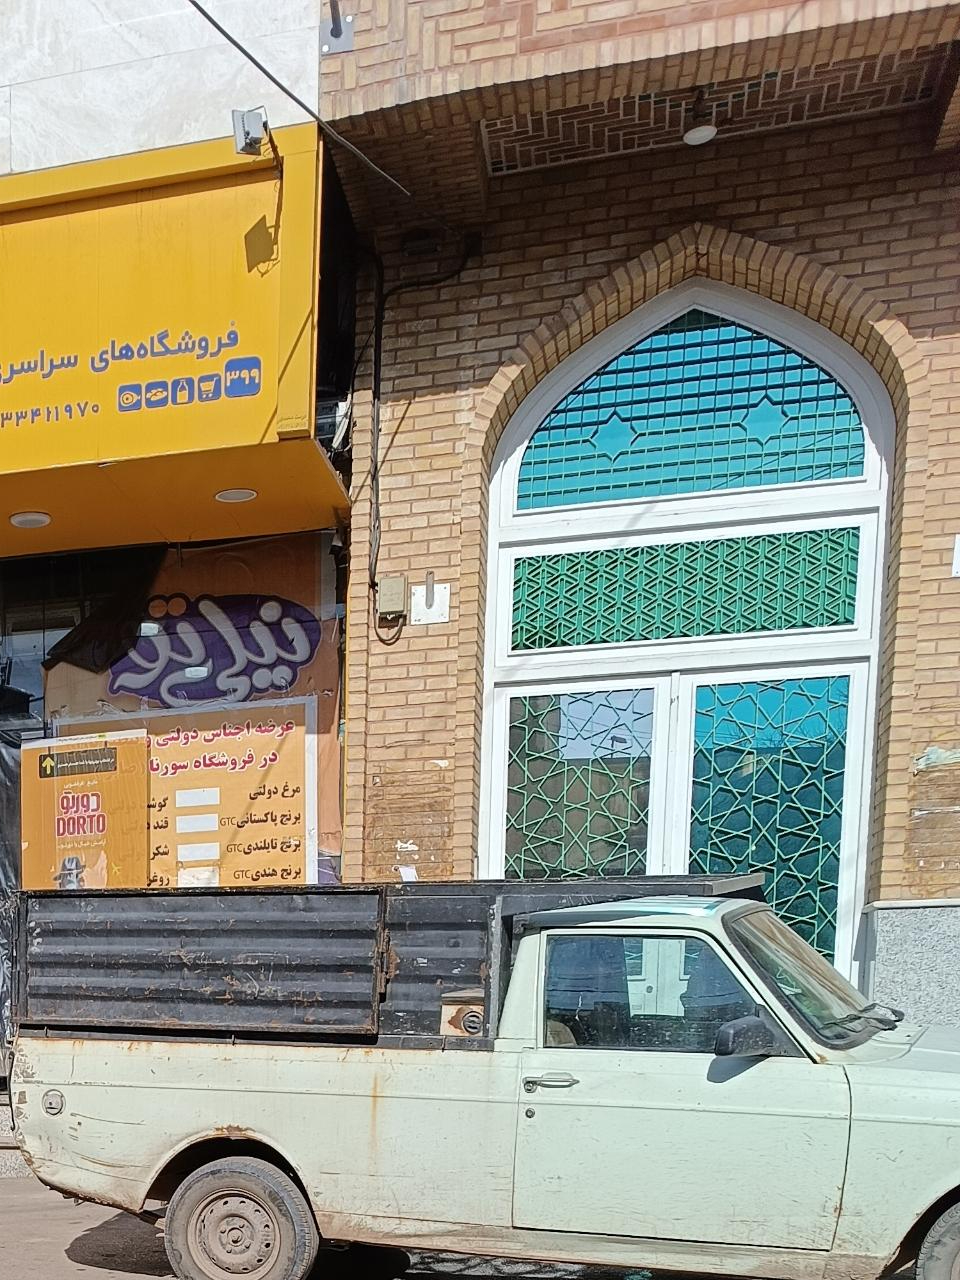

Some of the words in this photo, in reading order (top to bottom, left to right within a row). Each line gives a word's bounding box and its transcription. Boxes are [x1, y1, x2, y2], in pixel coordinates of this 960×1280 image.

[156, 727, 199, 747] دولتی
[203, 721, 251, 742] اجناس
[255, 719, 295, 740] عرضه
[149, 758, 189, 776] سورنا
[193, 748, 255, 771] فروشگاه
[258, 750, 279, 769] در
[249, 785, 279, 800] دولتی
[281, 781, 301, 798] مرغ
[56, 814, 106, 837] DORTO
[153, 816, 169, 830] قند
[219, 816, 236, 827] GTC
[236, 811, 277, 828] پاکستانی
[280, 810, 301, 825] برنج
[149, 844, 170, 861] شکر
[226, 843, 244, 853] GTC
[243, 838, 277, 855] تایلندی
[280, 837, 301, 852] برنج
[233, 869, 251, 880] GTC
[251, 869, 277, 881] هندی
[280, 864, 302, 880] برنج
